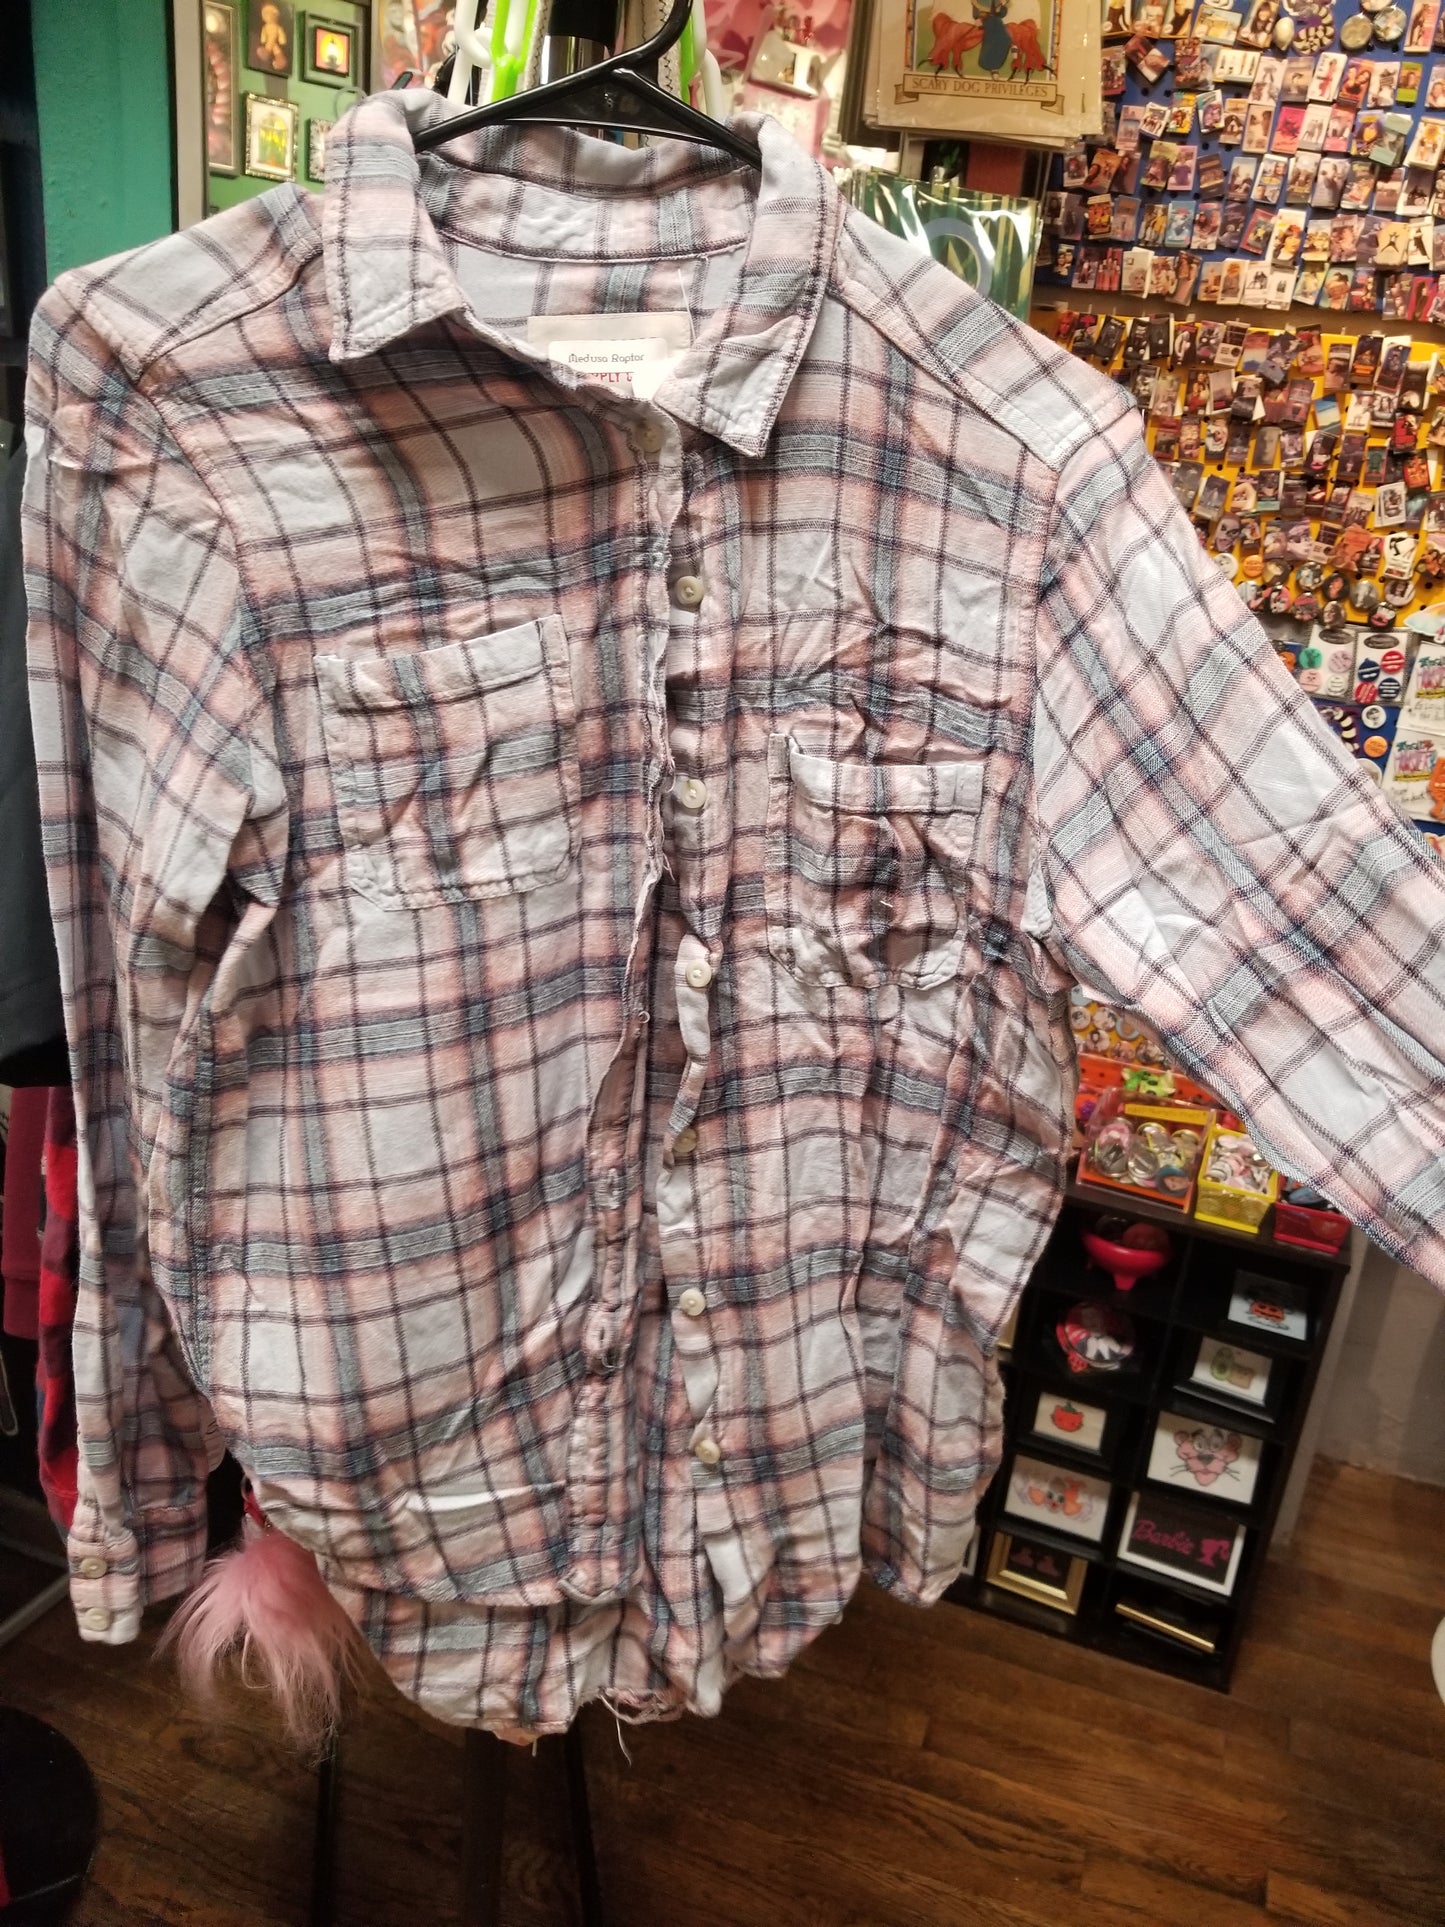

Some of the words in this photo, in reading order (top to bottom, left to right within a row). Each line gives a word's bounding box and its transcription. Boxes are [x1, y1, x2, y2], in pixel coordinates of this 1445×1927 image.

[912, 78, 949, 91] SCARY
[953, 80, 980, 94] DOG
[984, 82, 1048, 97] PRIVILEGES
[568, 353, 608, 363] Medusa
[612, 353, 645, 363] Raptor
